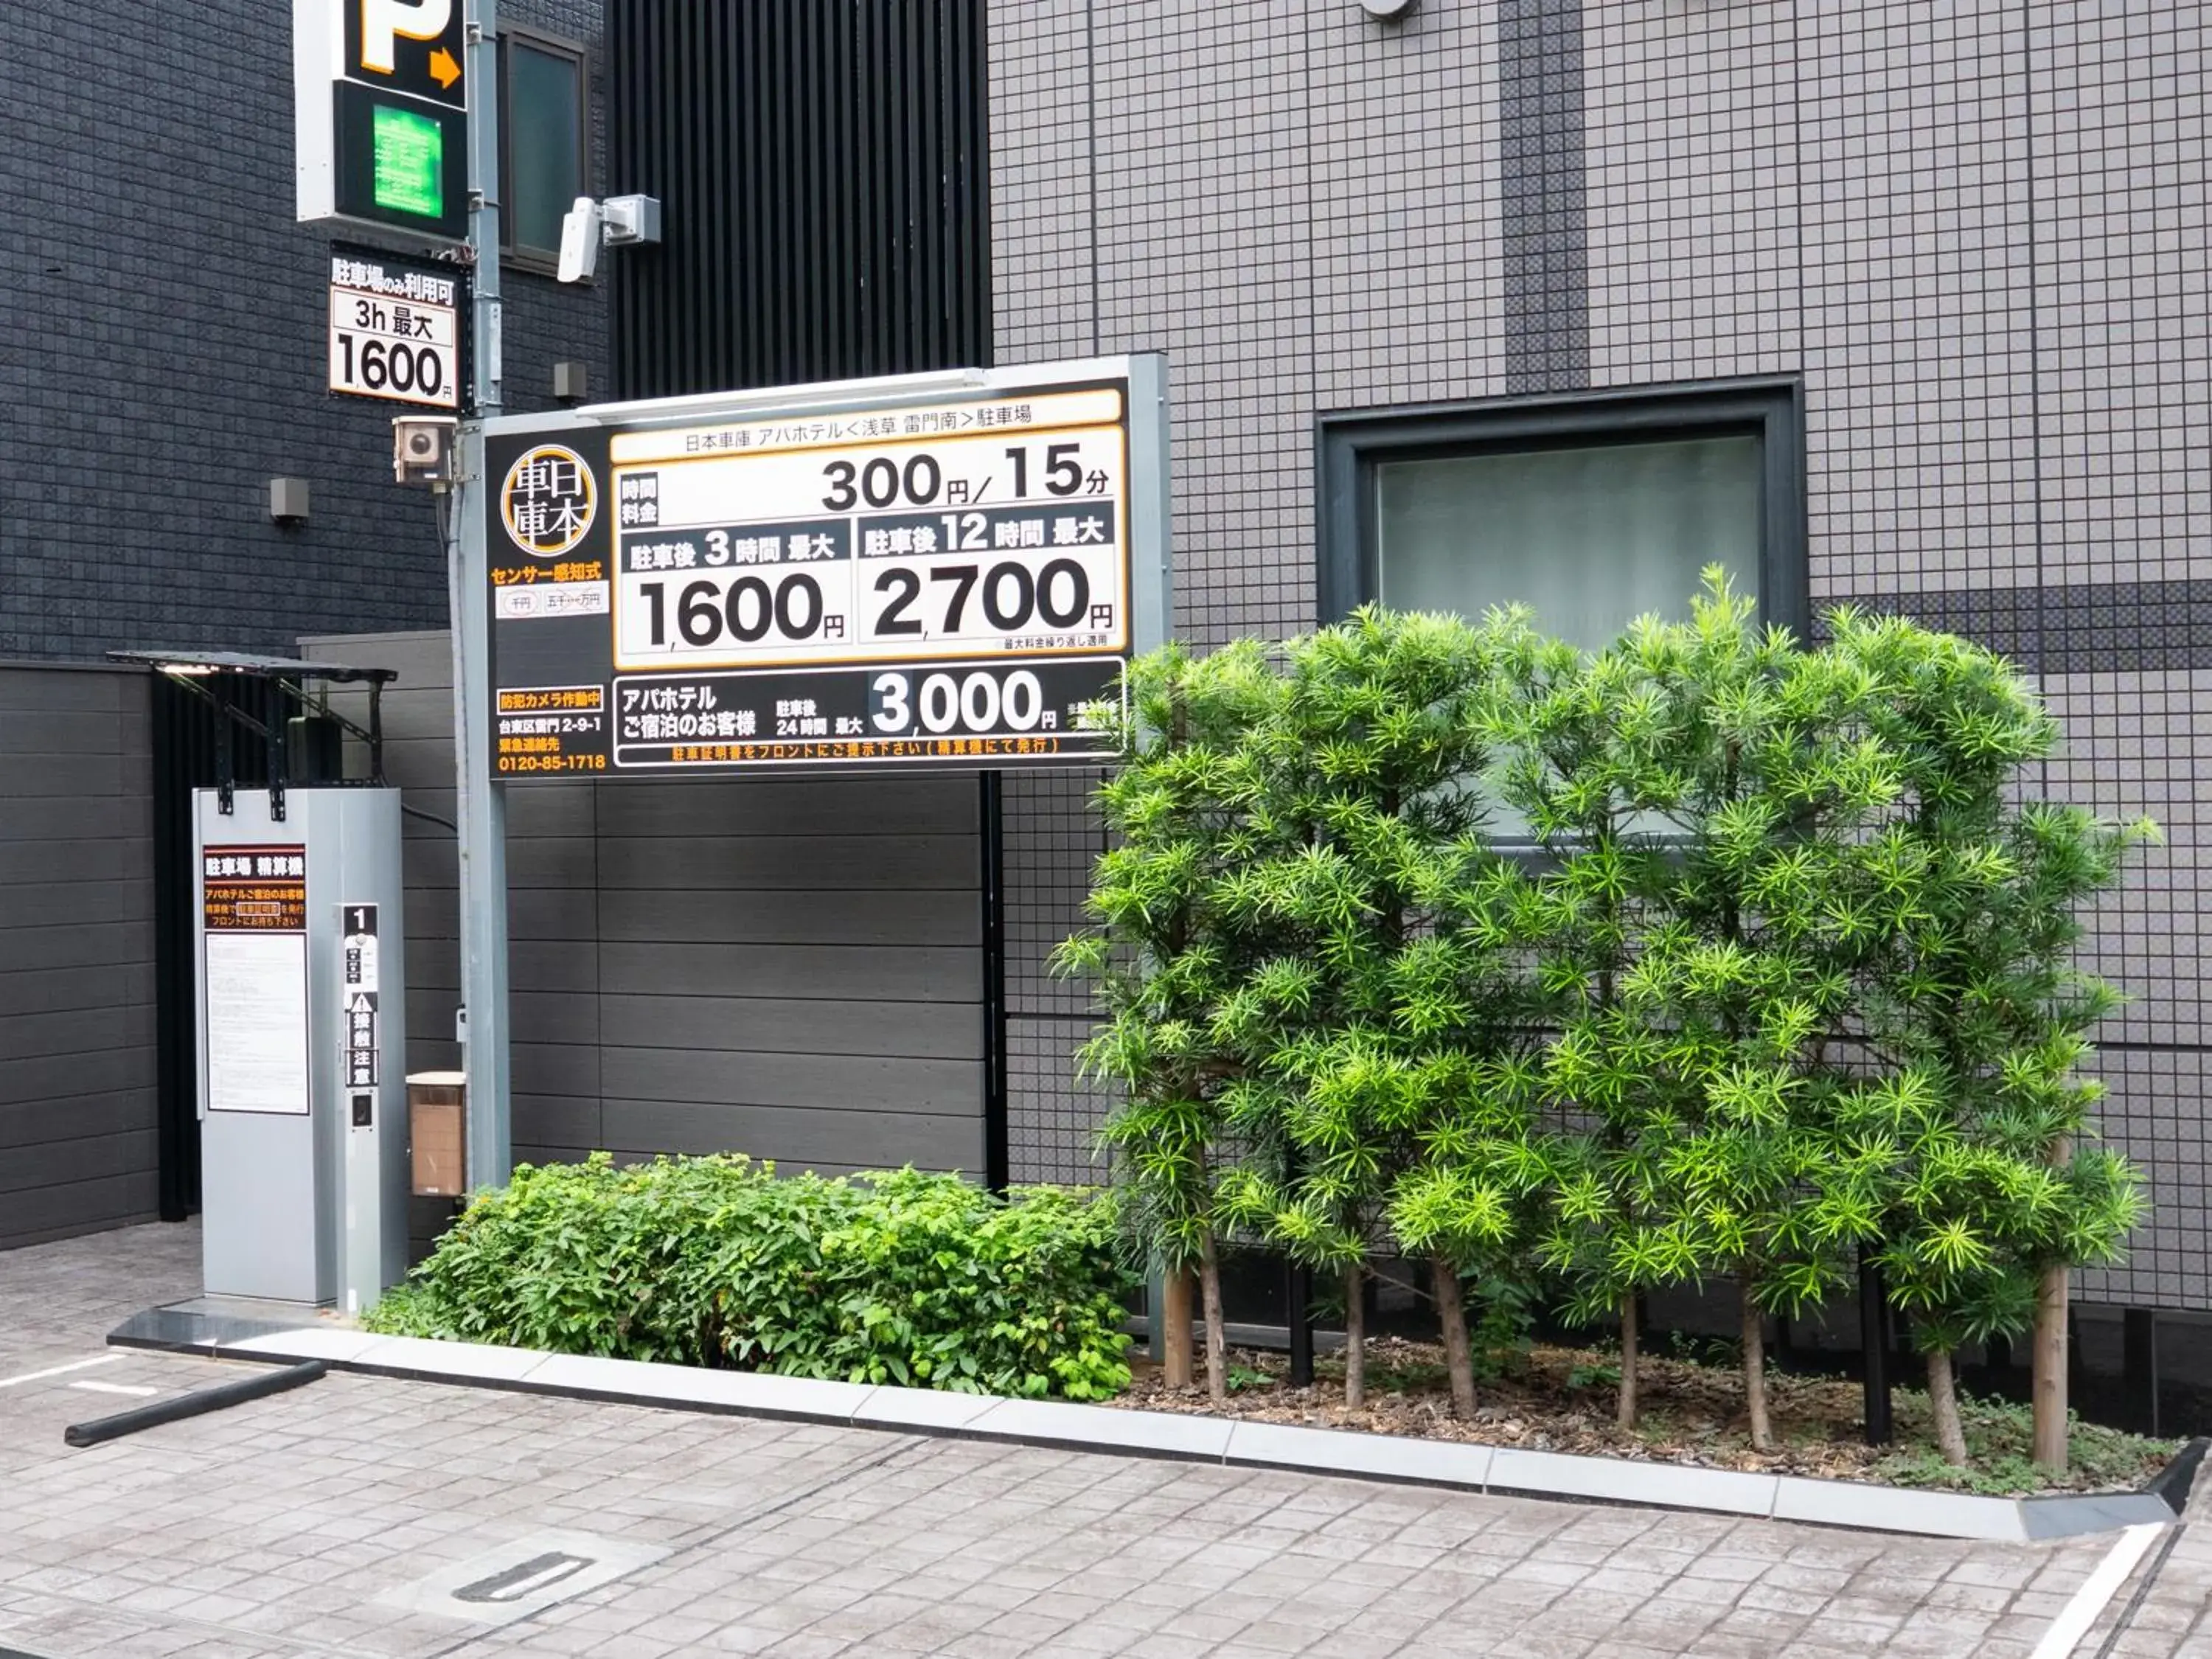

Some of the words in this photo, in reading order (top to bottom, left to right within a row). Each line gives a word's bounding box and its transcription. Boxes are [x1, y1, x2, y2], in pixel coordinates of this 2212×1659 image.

[361, 0, 452, 74] P
[332, 257, 454, 305] 駐車場のみ利用可
[355, 300, 386, 330] 3h
[393, 306, 433, 339] 最大
[686, 430, 751, 452] 日本車庫
[491, 562, 602, 585] センサー感知式
[501, 691, 600, 709] 防犯カメラ作動中
[623, 686, 717, 712] アパホテル
[776, 699, 816, 717] 駐車後
[623, 710, 757, 738] ご宿泊のお客様
[498, 755, 606, 771] 0120-85-1718
[353, 908, 366, 930] 1
